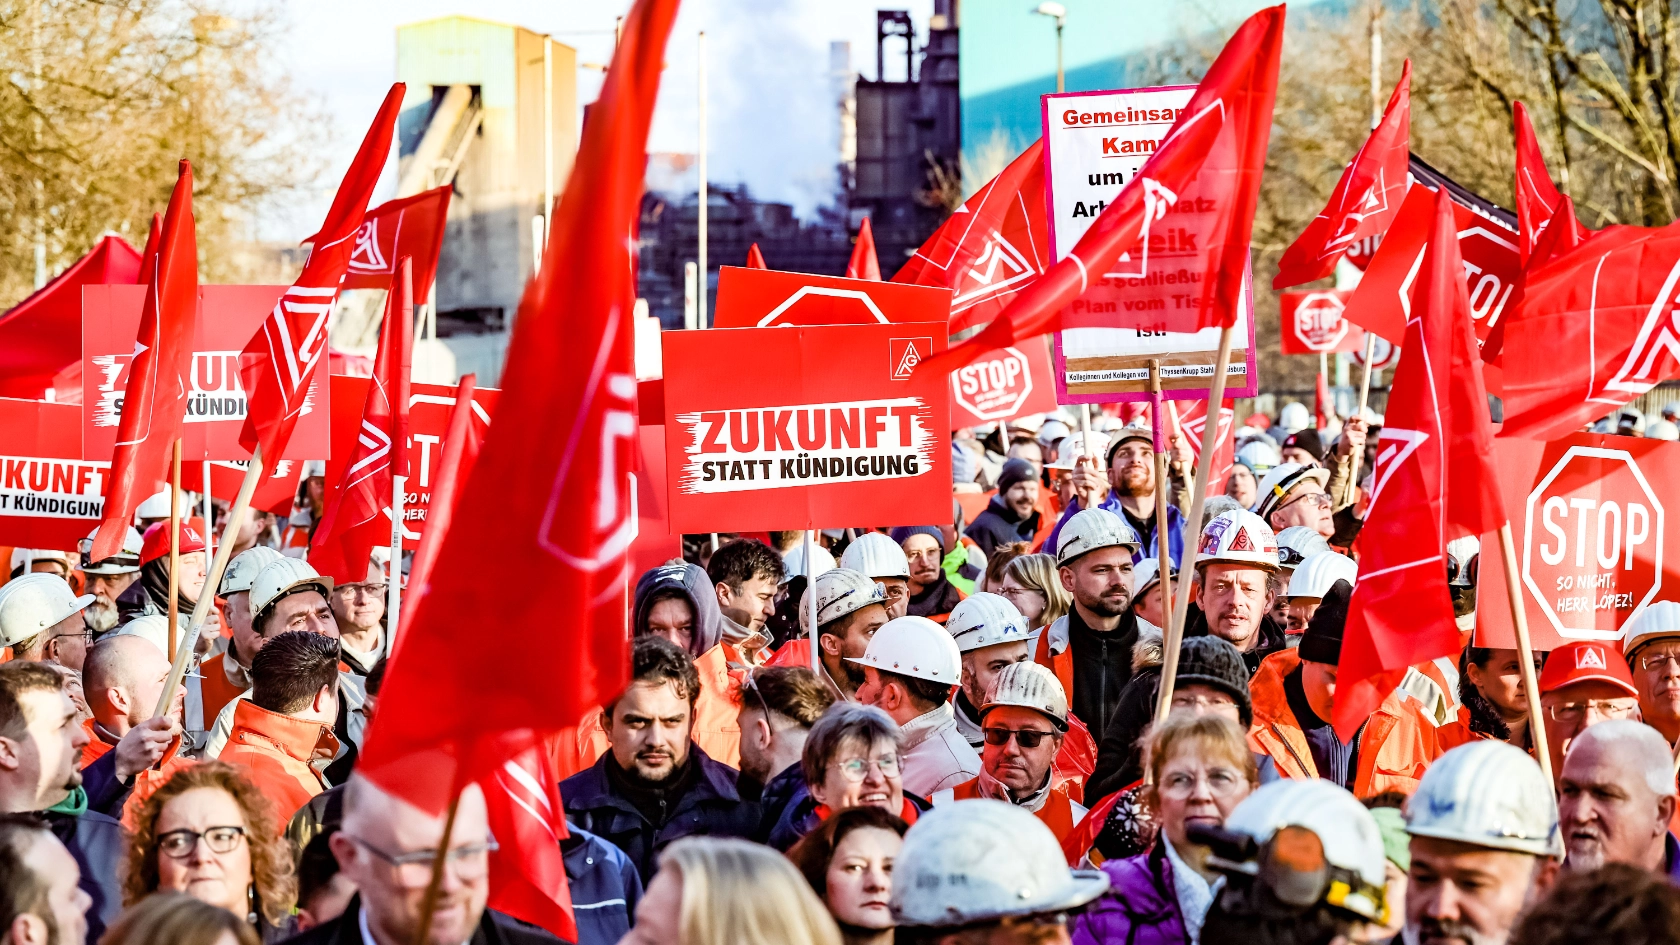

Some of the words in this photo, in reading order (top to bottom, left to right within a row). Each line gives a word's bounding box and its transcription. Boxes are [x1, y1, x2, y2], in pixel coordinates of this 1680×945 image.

[1102, 136, 1163, 155] Kam
[1088, 172, 1124, 187] um
[1071, 299, 1117, 315] Plan
[1123, 298, 1165, 312] vom
[1171, 294, 1203, 310] Tis
[1300, 306, 1342, 331] STOP
[1136, 322, 1167, 338] ist!
[960, 357, 1021, 395] STOP
[1068, 373, 1101, 382] Kolleginnen
[1101, 372, 1112, 380] und
[1112, 371, 1137, 380] Kollegen
[1160, 367, 1200, 377] ThyssenKrupp
[700, 405, 920, 454] ZUKUNFT
[702, 459, 773, 482] STATT
[779, 452, 919, 480] KÜNDIGUNG
[14, 493, 103, 518] KÜNDIGUN
[403, 508, 428, 521] HER
[1540, 495, 1650, 571] STOP
[1556, 575, 1574, 592] SO
[1577, 572, 1617, 589] NICHT,
[1556, 596, 1590, 613] HERR
[1592, 590, 1634, 611] LÓPEZ!
